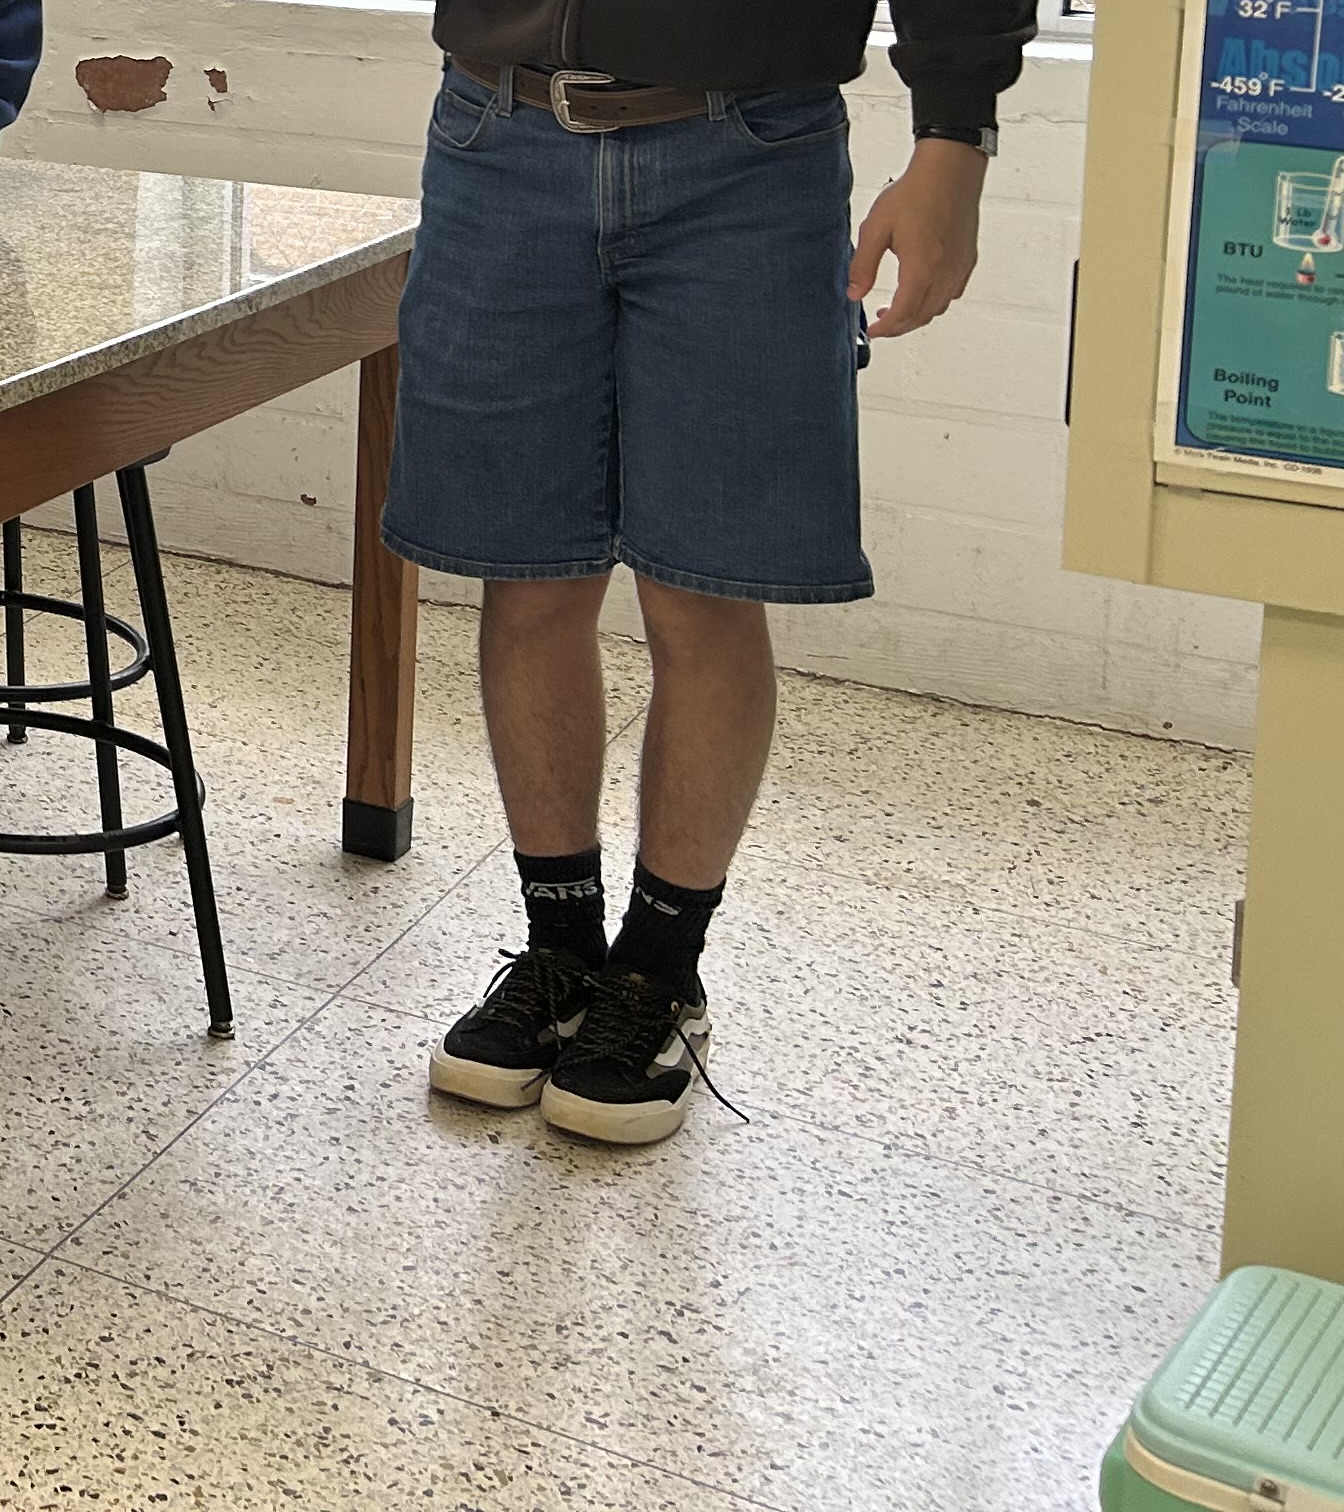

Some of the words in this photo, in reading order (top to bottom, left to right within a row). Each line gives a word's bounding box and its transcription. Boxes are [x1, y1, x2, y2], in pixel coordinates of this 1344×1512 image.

[1216, 95, 1313, 118] Fahrenheit
[1237, 116, 1289, 135] Scale
[1223, 241, 1264, 258] BTU
[1214, 368, 1280, 392] Boiling
[1224, 390, 1272, 408] Point
